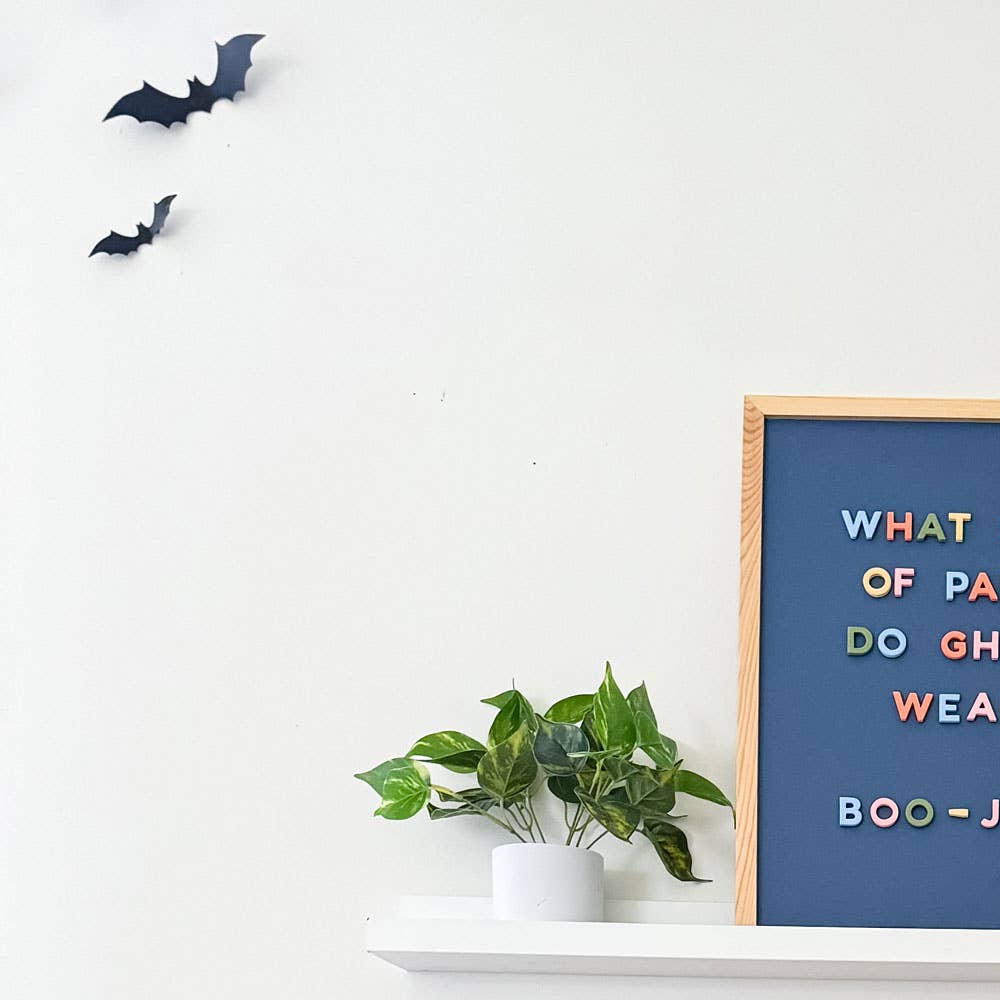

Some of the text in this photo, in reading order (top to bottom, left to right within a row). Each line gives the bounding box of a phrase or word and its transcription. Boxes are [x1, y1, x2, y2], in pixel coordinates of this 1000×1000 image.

[841, 510, 971, 543] WHAT
[862, 567, 915, 599] OF
[846, 626, 907, 659] DO
